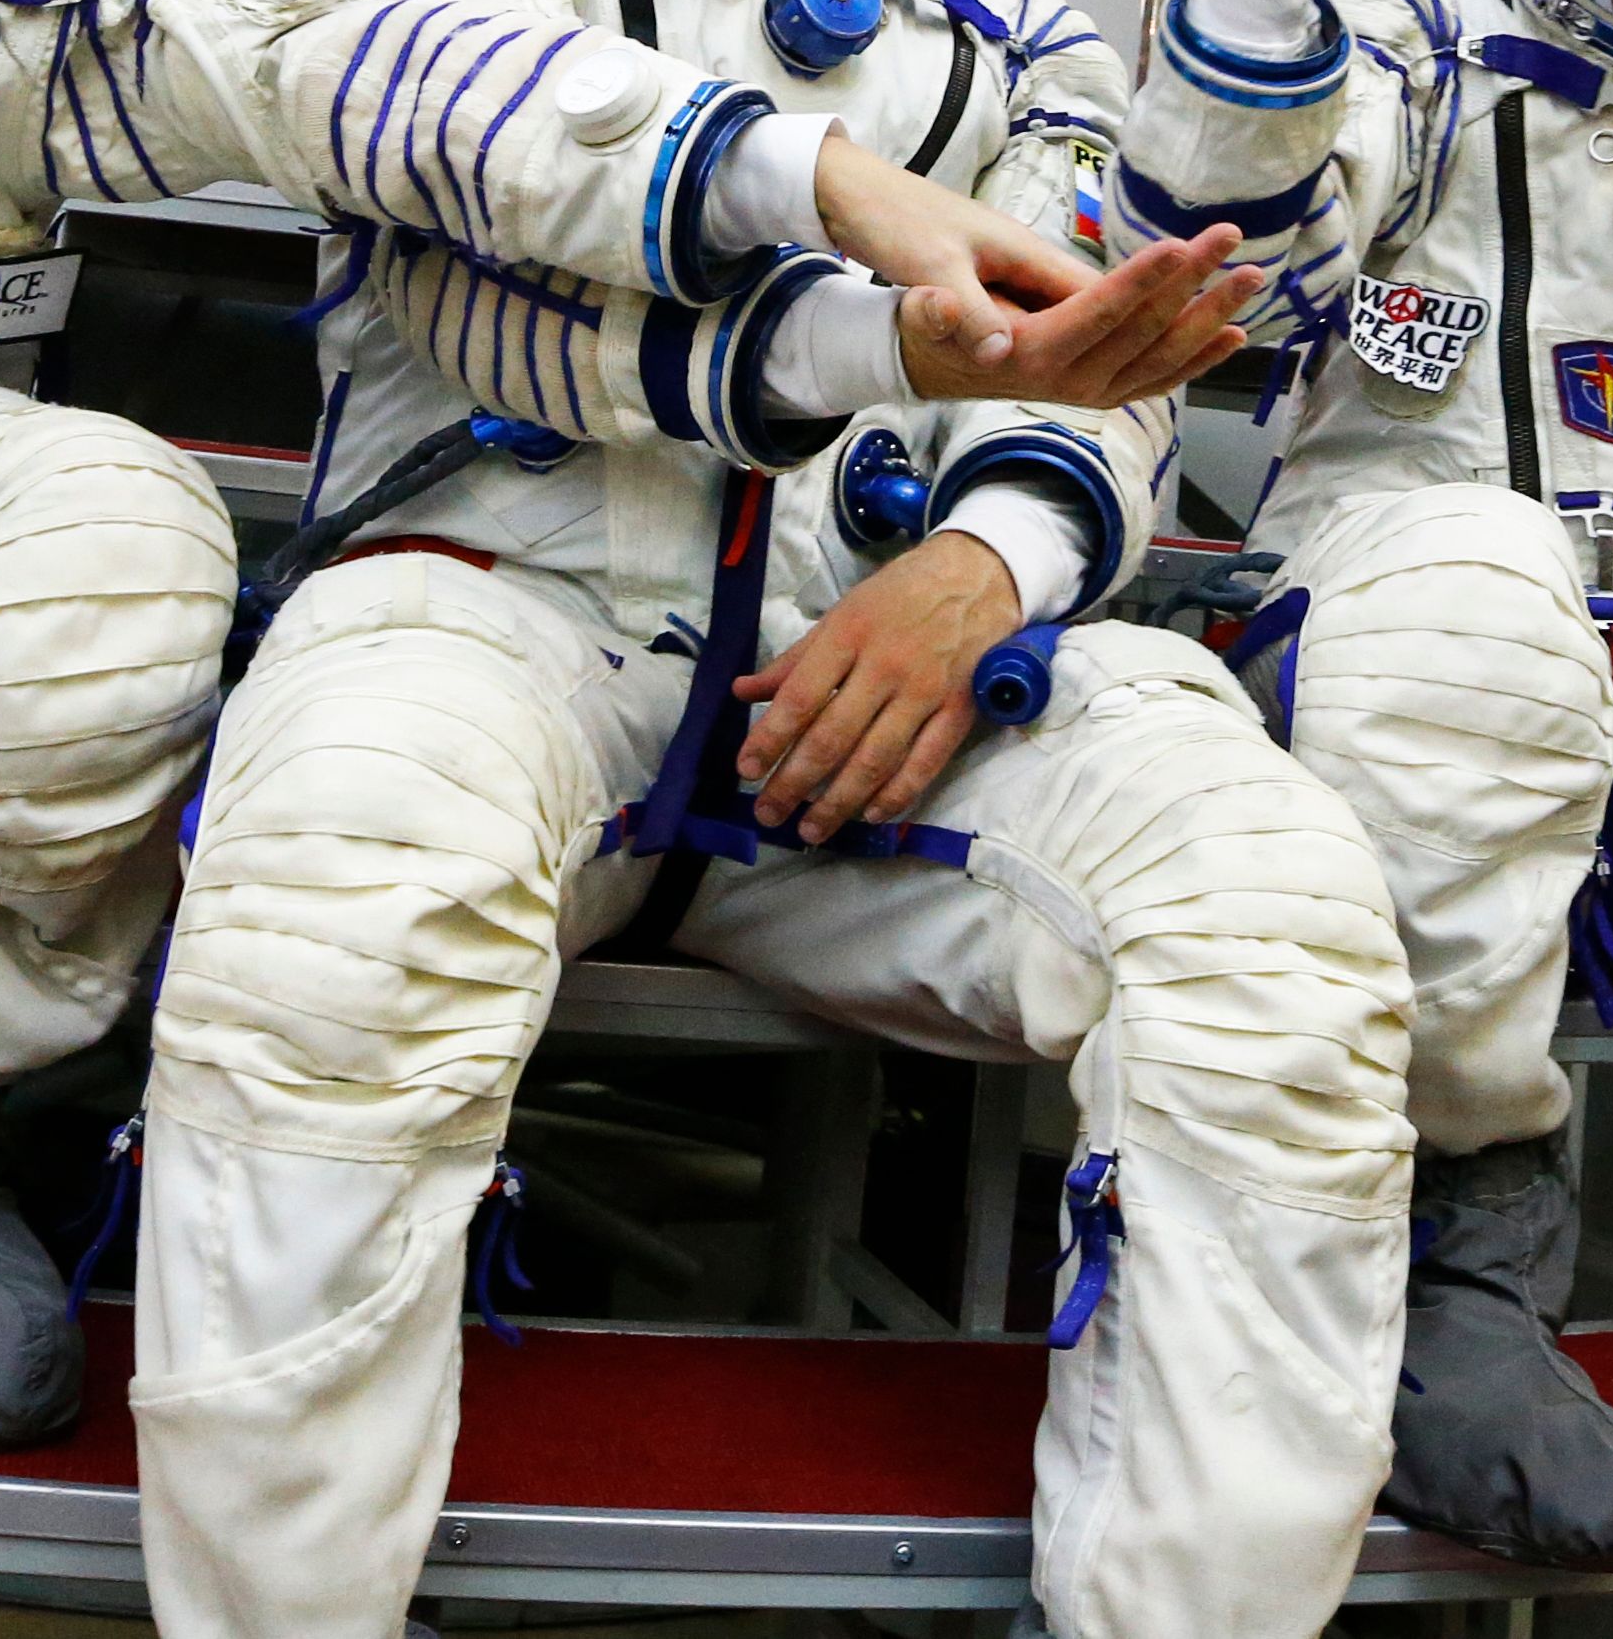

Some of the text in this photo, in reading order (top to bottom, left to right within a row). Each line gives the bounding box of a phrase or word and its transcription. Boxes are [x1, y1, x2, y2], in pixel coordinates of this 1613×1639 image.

[1354, 308, 1463, 363] PEACE
[1354, 332, 1444, 384] 世界平和
